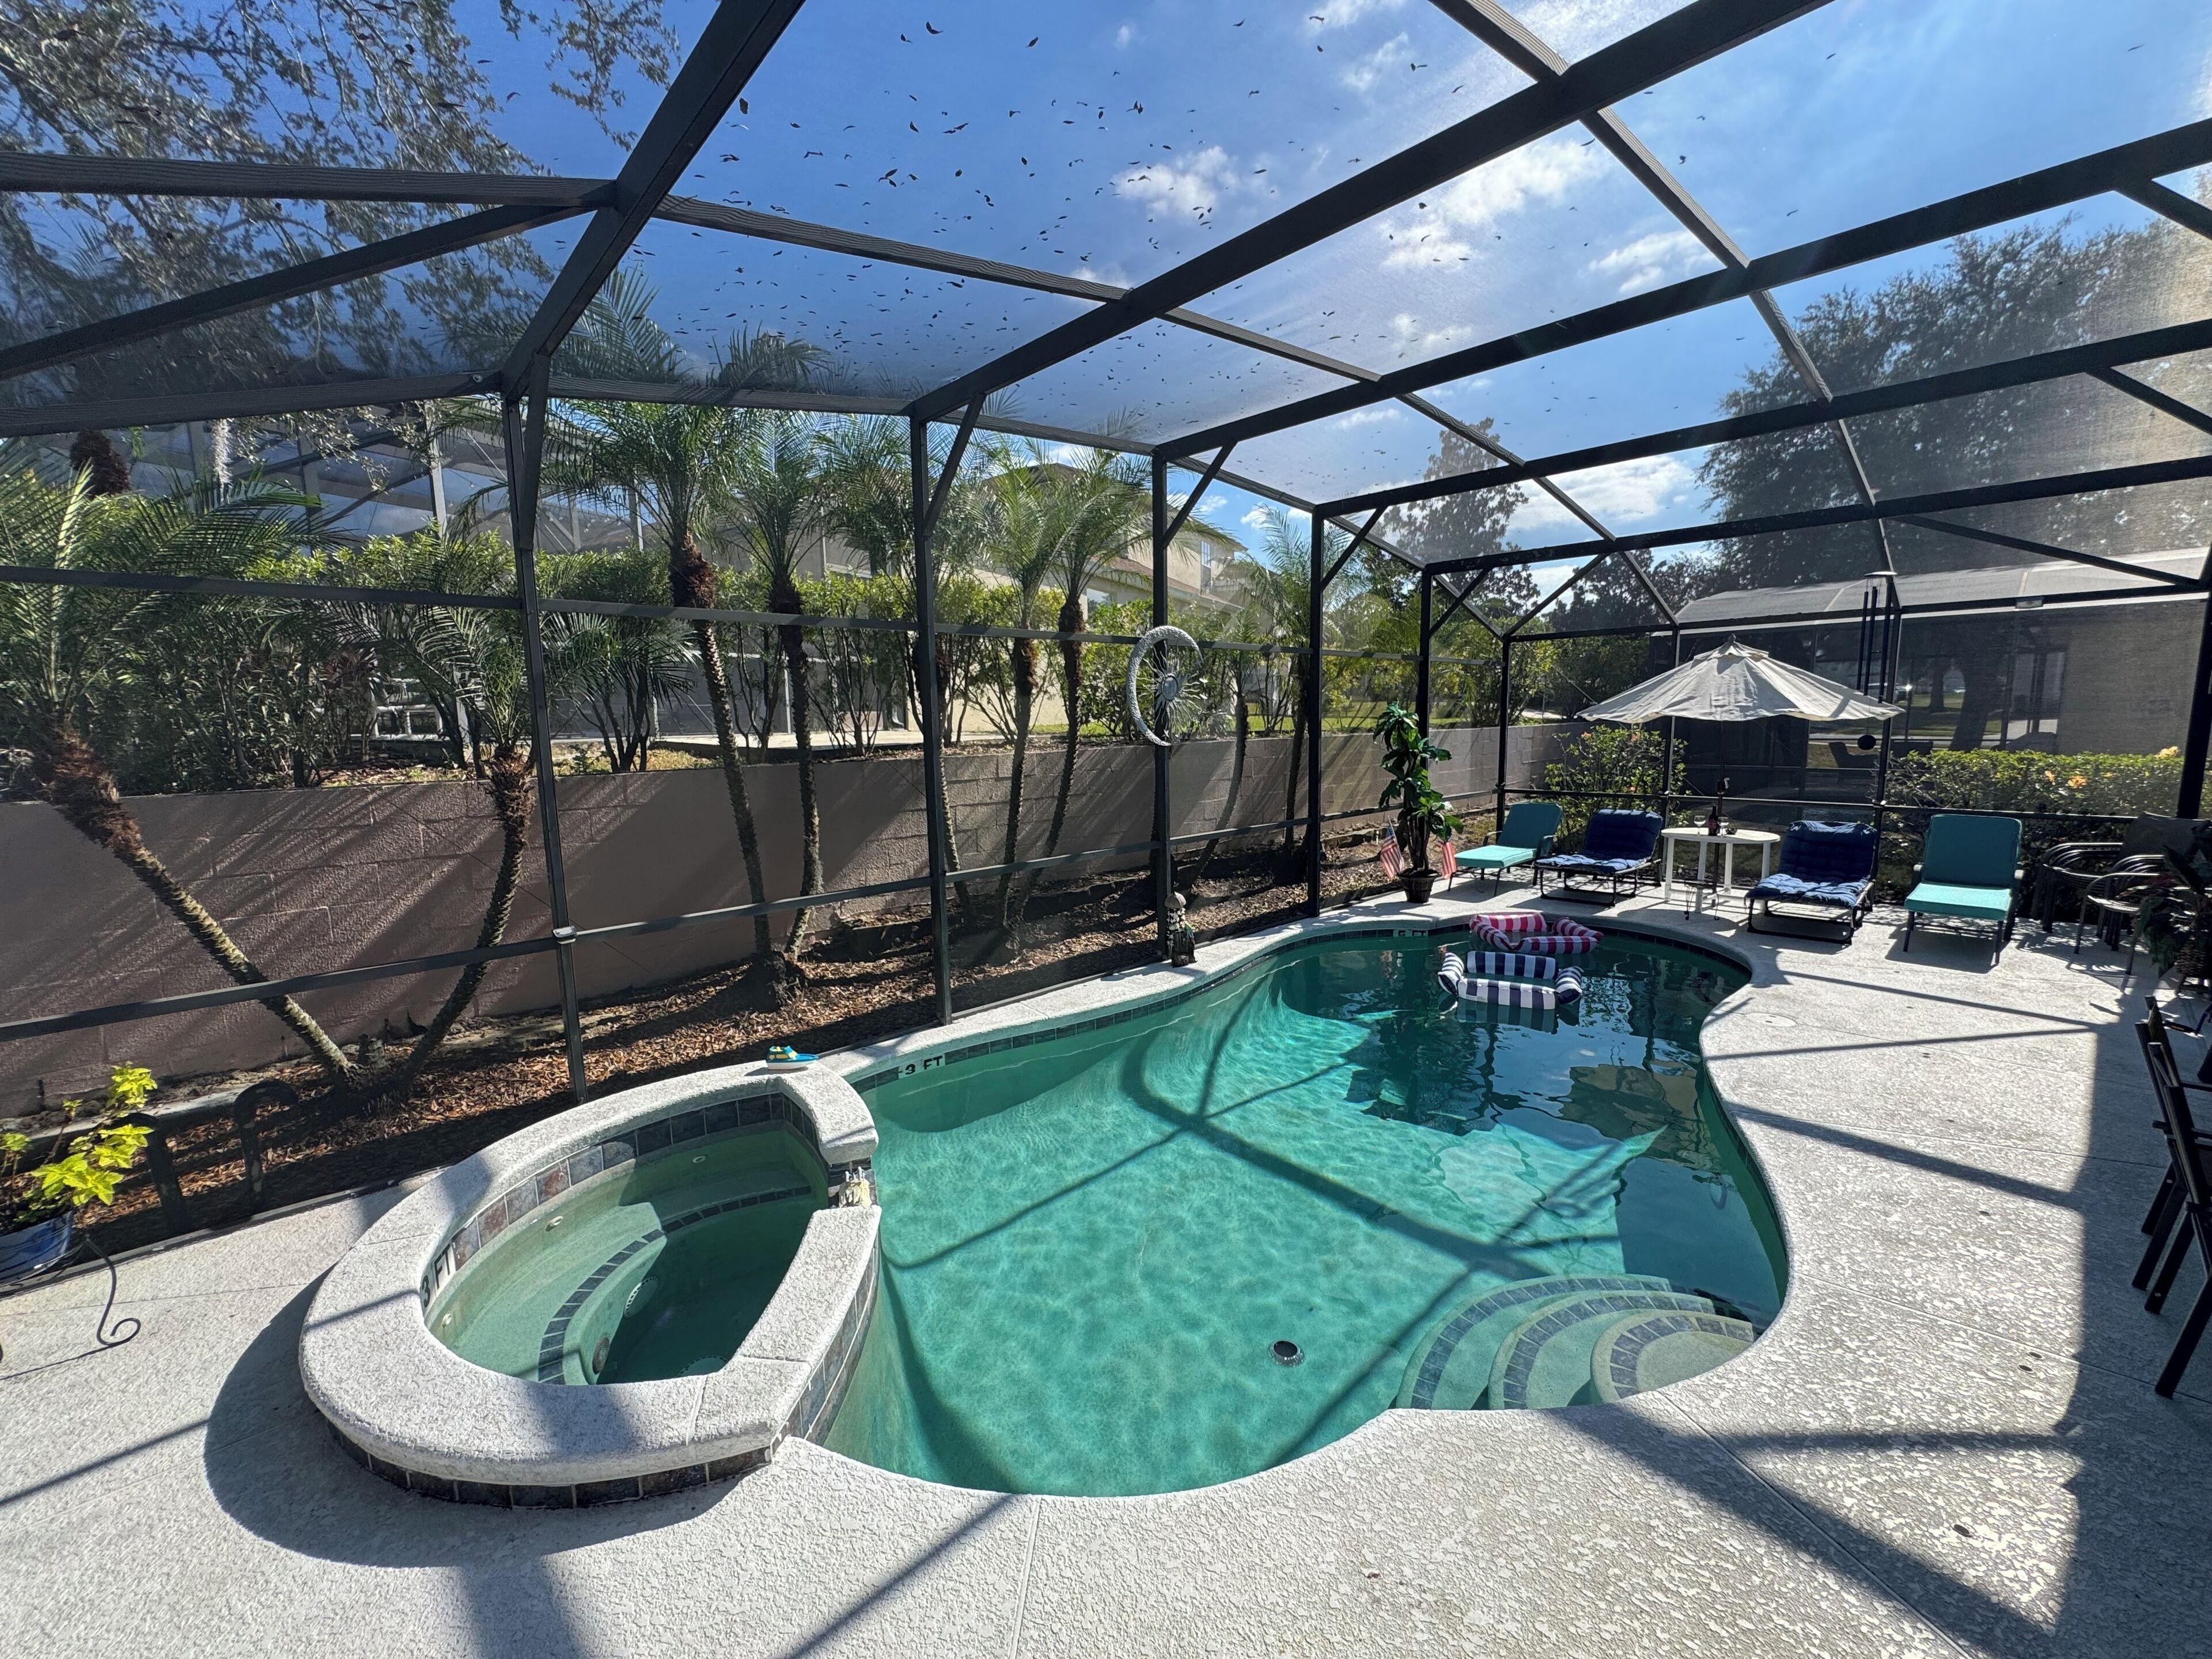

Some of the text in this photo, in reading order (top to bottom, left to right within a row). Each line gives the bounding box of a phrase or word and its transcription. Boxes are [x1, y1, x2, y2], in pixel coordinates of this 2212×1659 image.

[905, 1055, 942, 1075] 3 FT
[422, 1243, 450, 1308] 3 FT
